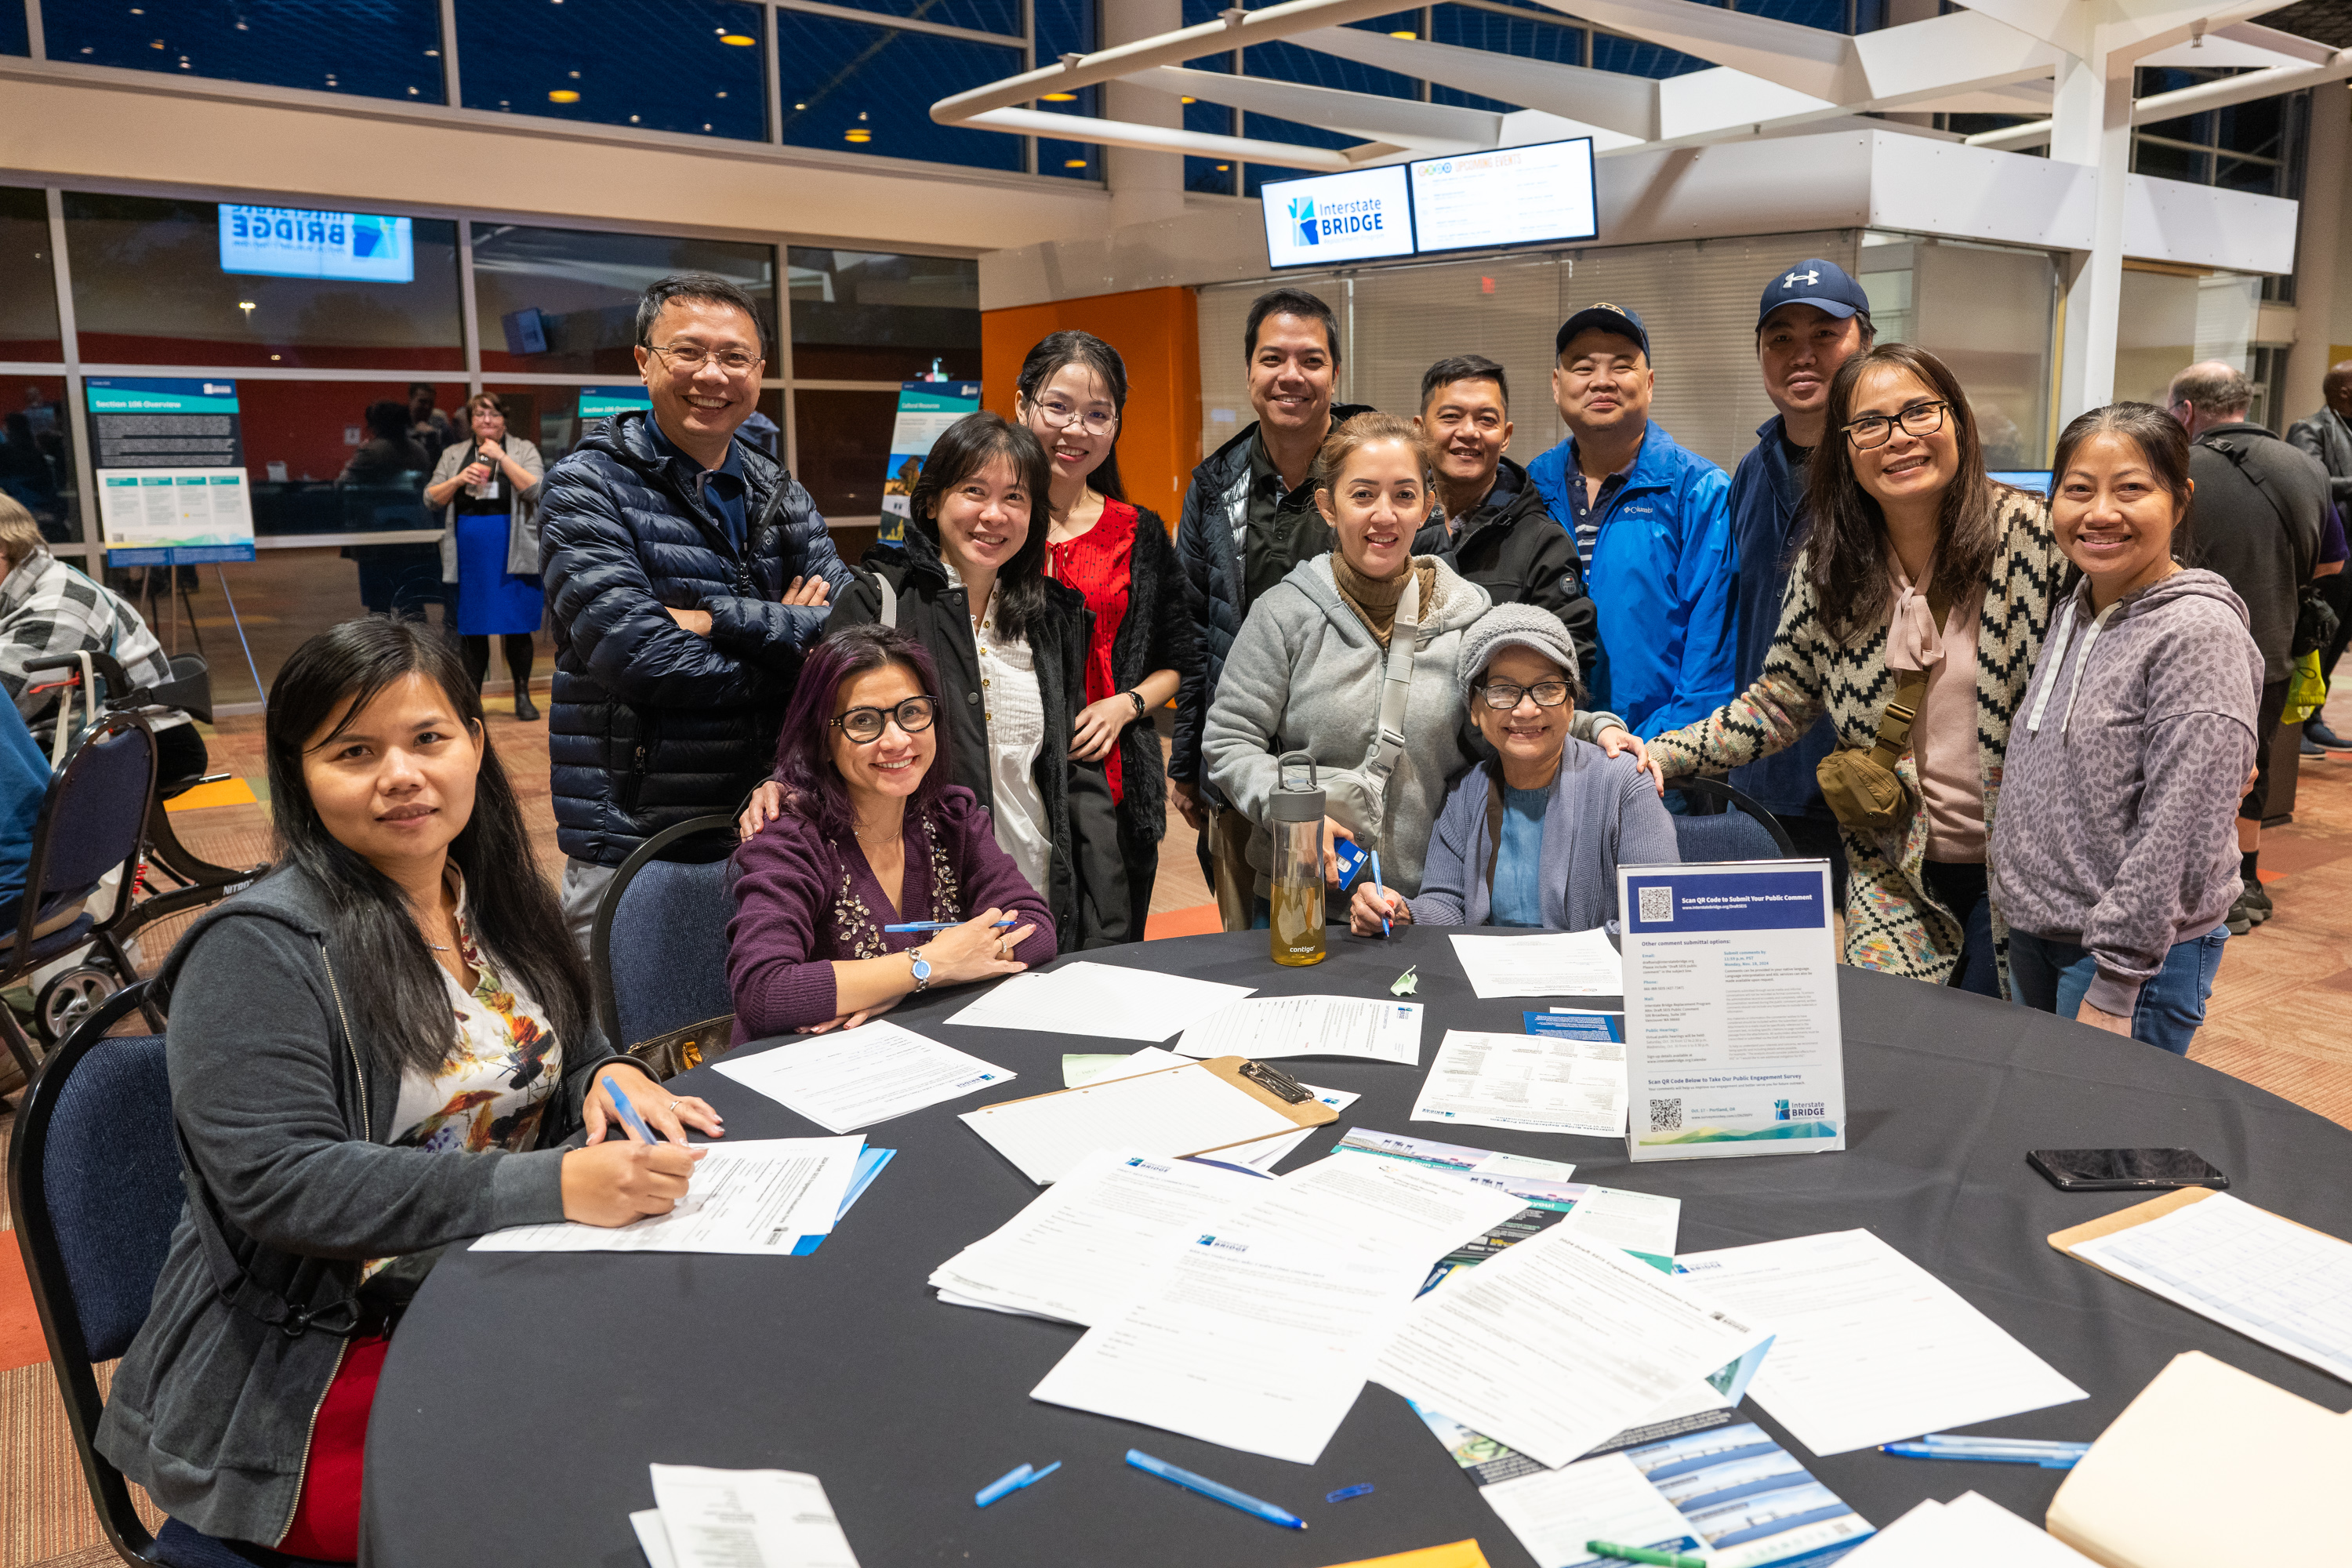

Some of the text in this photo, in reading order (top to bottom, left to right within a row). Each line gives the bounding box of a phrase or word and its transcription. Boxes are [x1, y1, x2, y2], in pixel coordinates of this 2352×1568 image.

[1455, 153, 1522, 172] UPCOMING EVENTS
[1319, 198, 1382, 216] Interstate
[1322, 213, 1384, 235] BRIDGE
[96, 400, 126, 408] Section
[143, 400, 182, 408] Overview
[1791, 1108, 1825, 1116] BRIDGE
[1140, 1163, 1171, 1173] BRIDGE
[1410, 1160, 1432, 1168] from
[1532, 1200, 1555, 1210] you!
[1214, 1242, 1248, 1253] BRIDGE
